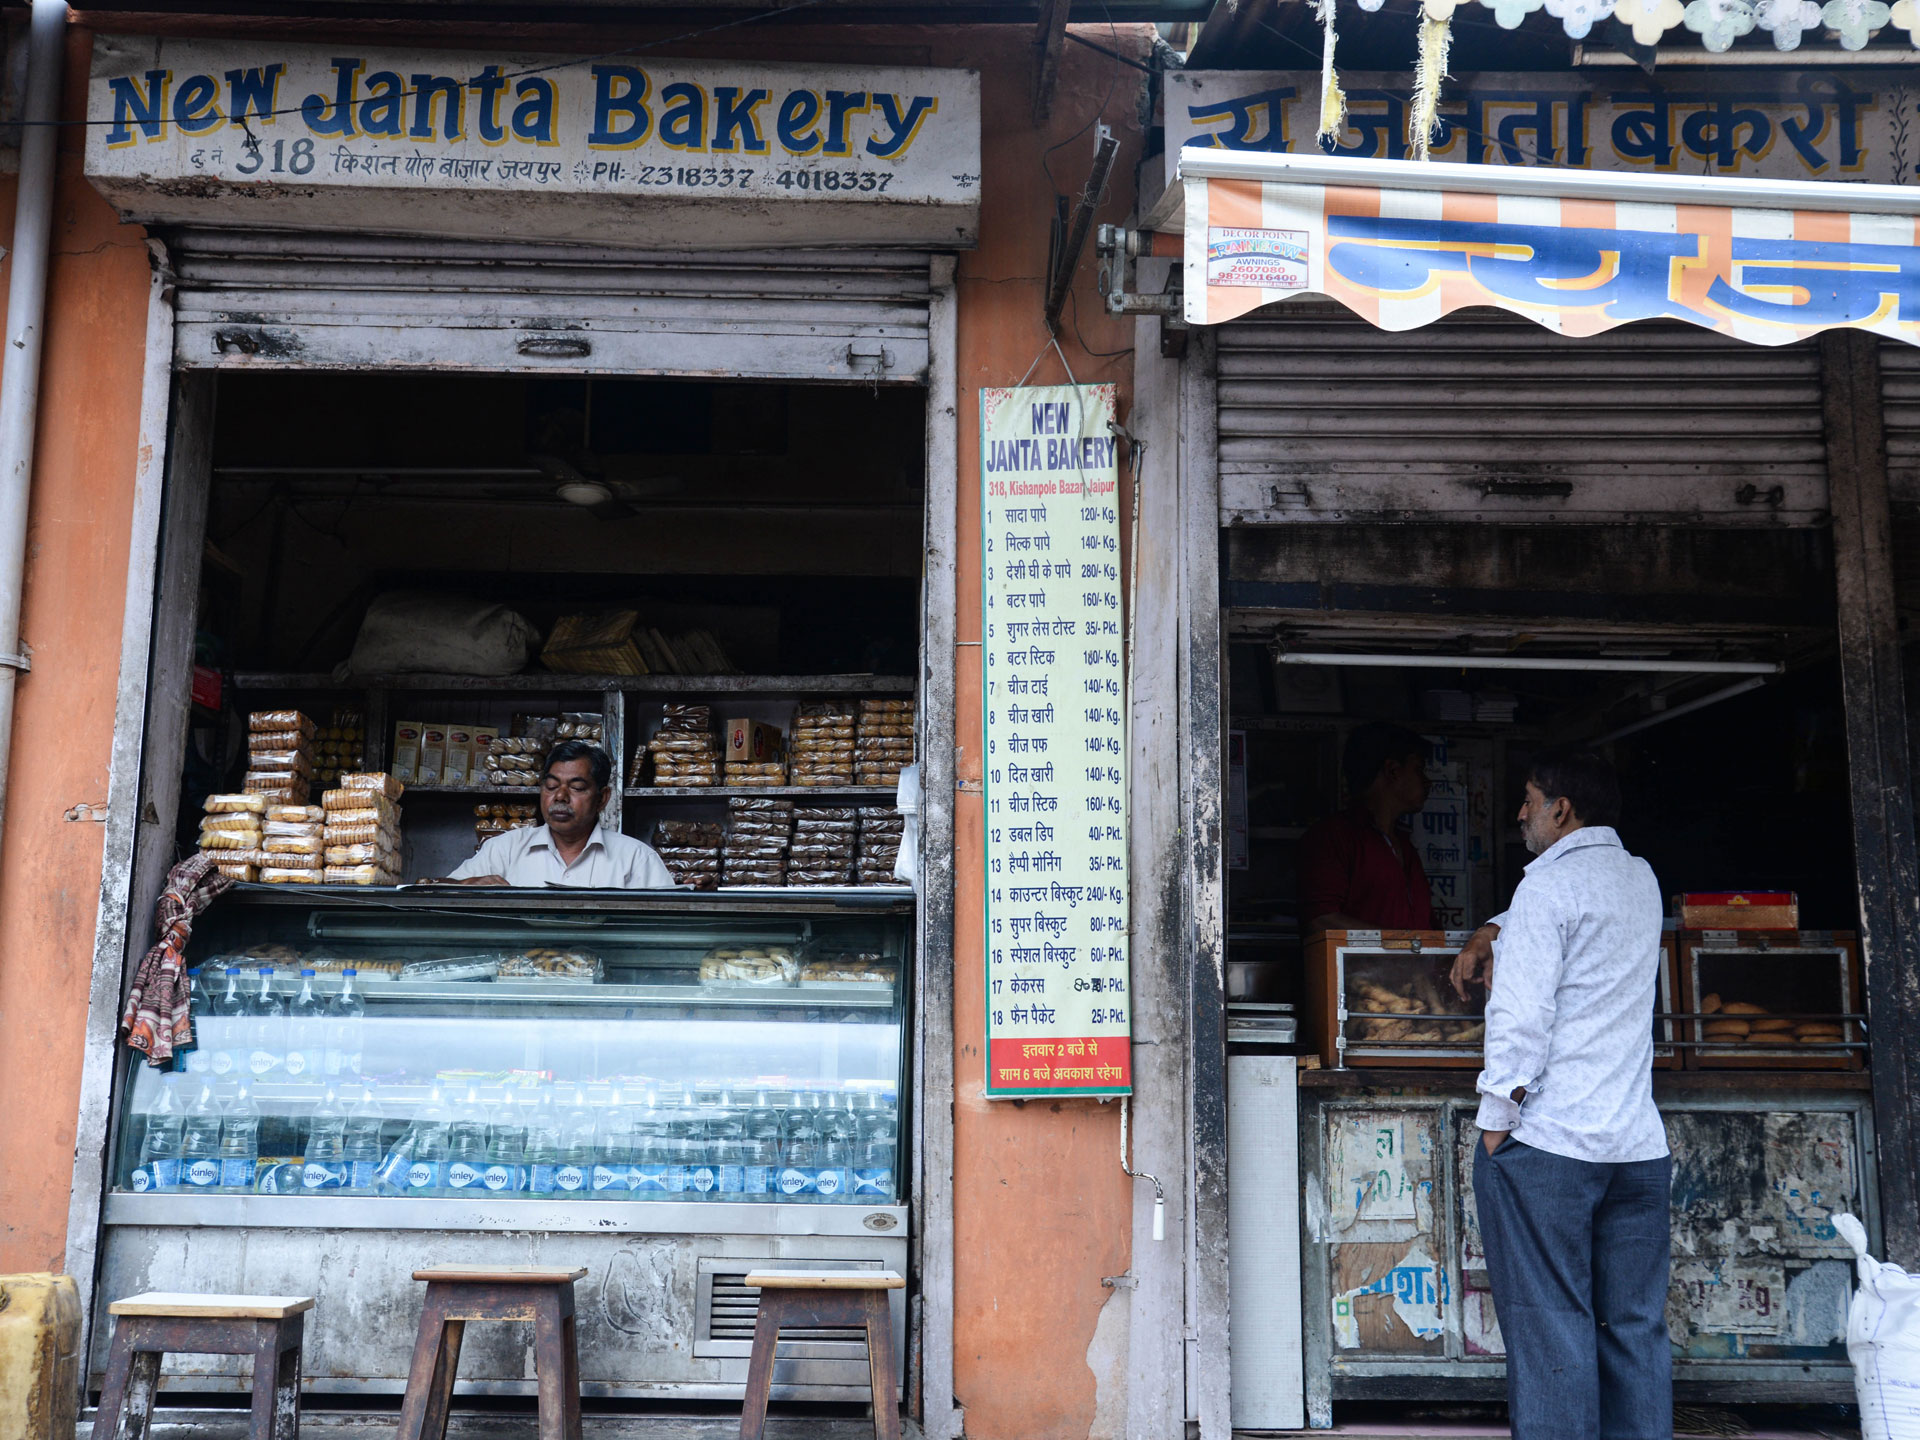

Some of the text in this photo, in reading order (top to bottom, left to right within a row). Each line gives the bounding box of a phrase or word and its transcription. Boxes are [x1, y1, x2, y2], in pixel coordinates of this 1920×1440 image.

[106, 57, 939, 160] New Janta Bakery
[235, 138, 316, 175] 318
[497, 160, 561, 184] जयपुर
[638, 165, 754, 189] 2318337
[776, 170, 894, 192] 4018337
[1223, 229, 1294, 240] DECOR POINT
[1230, 265, 1285, 274] 2607080
[1236, 258, 1280, 266] AWNINGS
[1218, 272, 1297, 281] 9829016400
[1032, 402, 1070, 434] NEW
[987, 435, 1116, 472] JANTA BAKERY
[989, 481, 1007, 498] 318,
[1010, 480, 1056, 498] Kishanpole
[1087, 478, 1115, 497] Jaipur
[988, 510, 991, 523] 1
[1005, 509, 1027, 523] सादा
[1030, 503, 1046, 522] पापे
[1103, 507, 1116, 523] Kg.
[988, 539, 993, 552] 2
[1006, 532, 1031, 551] मिल्क
[1033, 531, 1050, 550] पापे
[1103, 535, 1116, 552] Kg.
[988, 567, 993, 580] 3
[1006, 560, 1025, 580] देशी
[1028, 559, 1039, 579] घी
[1042, 559, 1051, 578] के
[1054, 559, 1071, 578] पापे
[1104, 564, 1117, 581] Kg.
[989, 595, 993, 608] 4
[1006, 594, 1026, 608] बटर
[1029, 588, 1045, 607] पापे
[1105, 592, 1118, 609] Kg.
[989, 624, 994, 637] 5
[1007, 623, 1029, 643] शुगर
[1032, 617, 1049, 636] लेस
[1052, 616, 1075, 635] टोस्ट
[1103, 621, 1118, 634] Pkt.
[989, 653, 994, 666] 6
[1007, 652, 1027, 665] बटर
[1030, 645, 1055, 665] स्टिक
[1106, 650, 1119, 667] Kg.
[990, 682, 994, 695] 7
[1008, 674, 1028, 694] चीज
[1031, 674, 1048, 696] टाई
[1106, 679, 1119, 696] Kg.
[990, 711, 995, 724] 8
[1008, 704, 1028, 724] चीज
[1031, 703, 1054, 723] खारी
[1107, 708, 1120, 725] Kg.
[990, 740, 995, 754] 9
[1008, 733, 1029, 753] चीज
[1031, 738, 1048, 752] पफ
[1107, 737, 1120, 754] Kg.
[991, 769, 1000, 783] 10
[1008, 763, 1028, 783] दिल
[1031, 761, 1053, 782] खारी
[1108, 767, 1121, 784] Kg.
[991, 799, 999, 813] 11
[1008, 792, 1029, 812] चीज
[1032, 792, 1058, 811] स्टिक
[1108, 797, 1122, 814] Kg.
[991, 829, 1000, 842] 12
[1009, 828, 1032, 841] डबल
[1035, 821, 1053, 841] डिप
[1107, 826, 1122, 840] Pkt.
[991, 859, 1001, 872] 13
[1009, 851, 1029, 873] हैप्पी
[1107, 856, 1123, 870] Pkt.
[992, 889, 1001, 902] 14
[1051, 881, 1083, 908] बिस्कुट
[1110, 887, 1123, 904] Kg.
[992, 919, 1002, 933] 15
[1010, 918, 1031, 939] सुपर
[1109, 917, 1124, 931] Pkt.
[992, 949, 1002, 963] 16
[1010, 943, 1040, 962] स्पेशल
[1044, 942, 1076, 969] बिस्कुट
[1109, 947, 1124, 961] Pkt.
[992, 980, 1002, 994] 17
[1010, 973, 1044, 993] केकरस
[1109, 978, 1125, 992] Pkt.
[993, 1011, 1003, 1025] 18
[1011, 1004, 1028, 1024] फैन
[1031, 1003, 1055, 1024] पैकेट
[1110, 1009, 1125, 1023] Pkt.
[1022, 1039, 1098, 1058] इतवार 2 बजे से
[999, 1063, 1122, 1080] शाम 6 बजे अवकाश रहेगा
